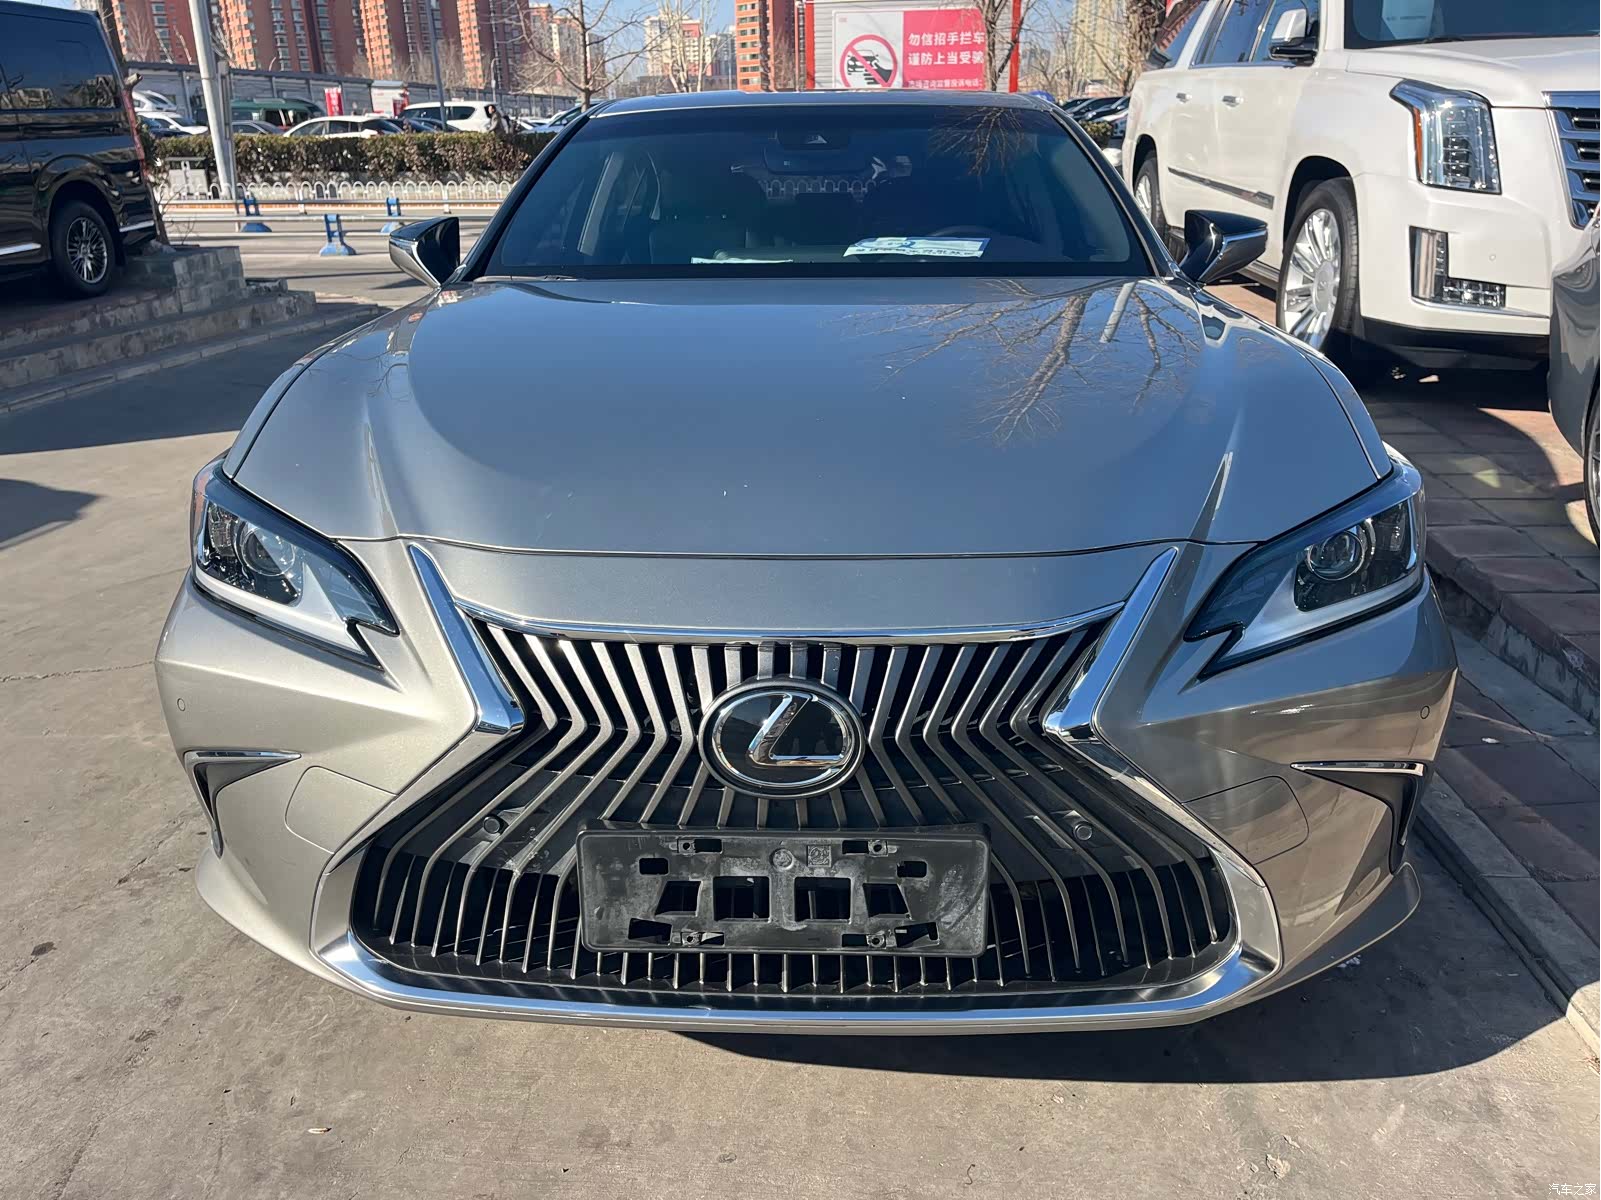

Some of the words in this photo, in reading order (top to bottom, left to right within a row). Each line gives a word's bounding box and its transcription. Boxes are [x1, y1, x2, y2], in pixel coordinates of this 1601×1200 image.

[908, 31, 985, 46] 勿信招手拦车
[908, 51, 984, 66] 谨防上当受骗
